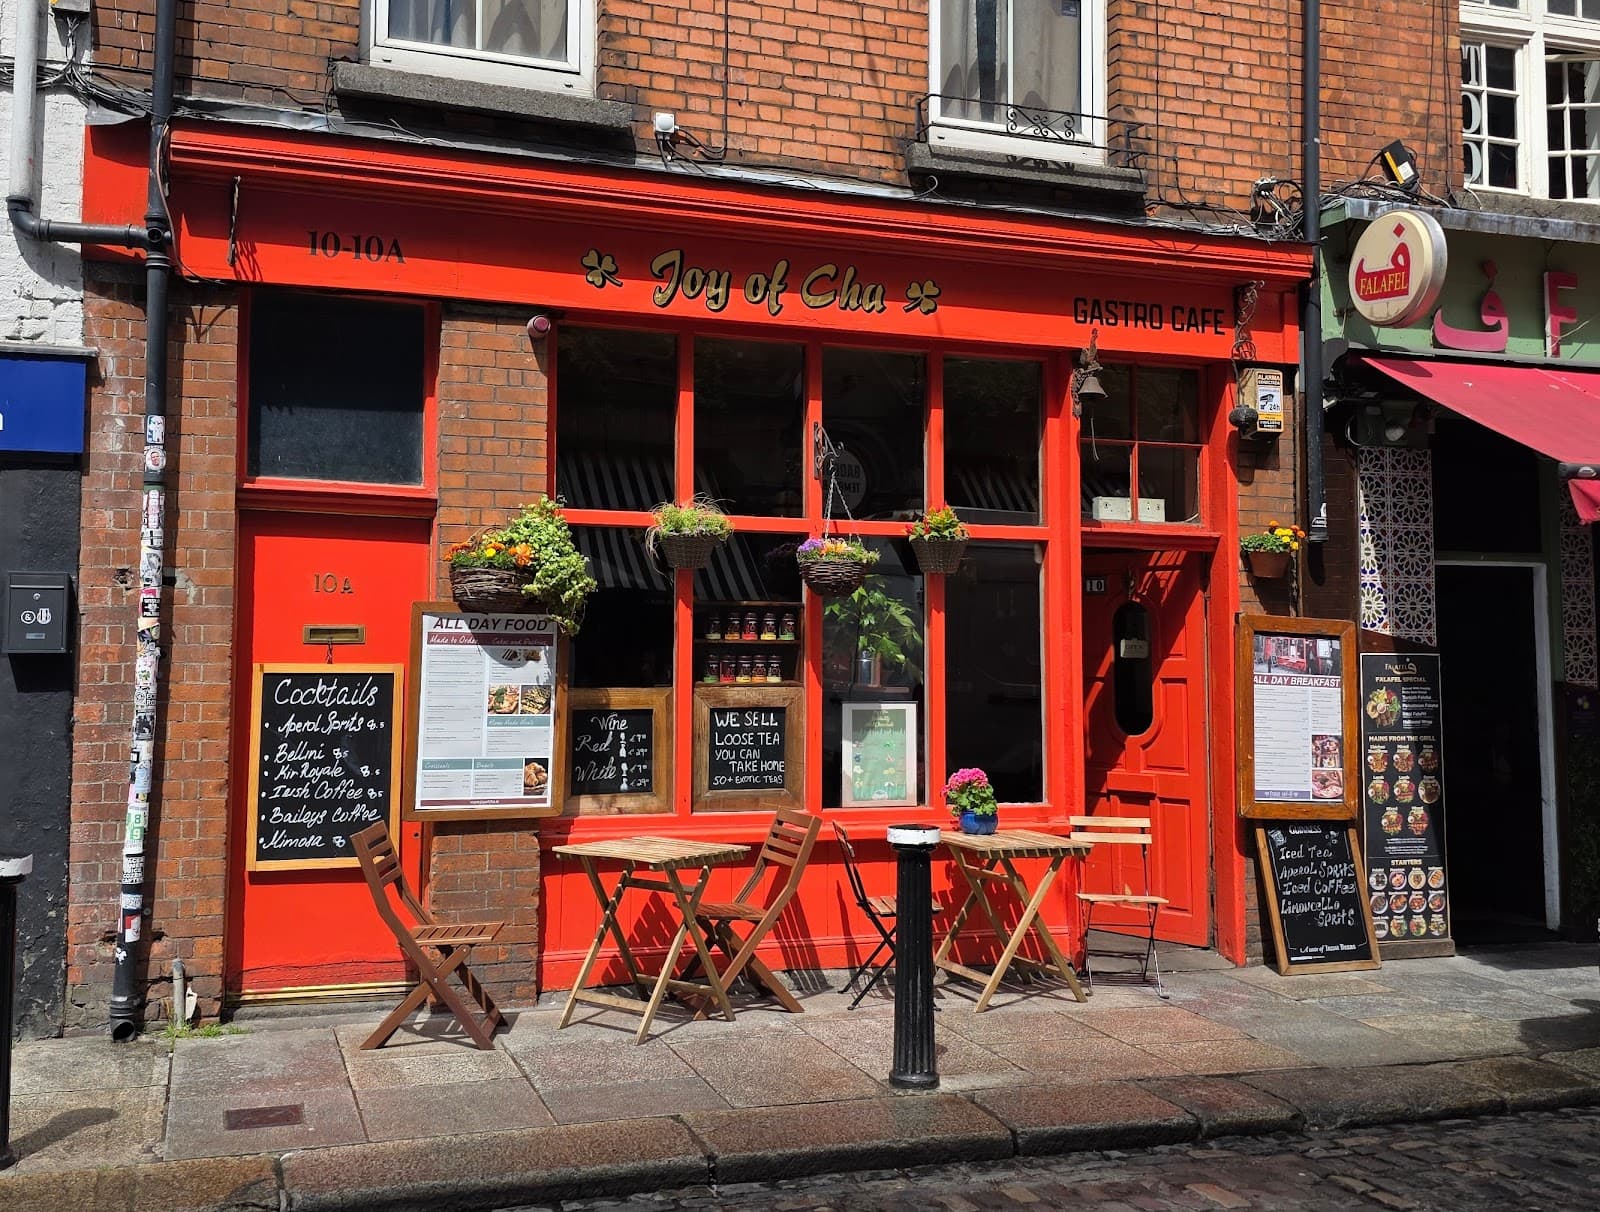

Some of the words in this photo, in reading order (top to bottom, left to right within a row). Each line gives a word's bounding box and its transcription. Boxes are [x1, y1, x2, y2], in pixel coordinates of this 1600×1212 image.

[307, 230, 406, 264] 10-10A
[651, 249, 732, 313] Joy
[744, 259, 790, 316] of
[801, 263, 887, 313] Cha
[1359, 273, 1408, 297] FALAFEL
[1073, 297, 1164, 331] GASTRO
[1171, 305, 1226, 336] CAFE
[313, 571, 354, 594] 10A
[1088, 579, 1104, 591] 10
[433, 617, 463, 630] ALL
[468, 618, 502, 631] DAY
[504, 618, 548, 632] FOOD
[275, 676, 379, 707] Cocktails
[1254, 675, 1269, 684] ALL
[1271, 676, 1290, 685] DAY
[1291, 677, 1341, 688] BREAKFAST
[277, 713, 323, 738] Aperol
[591, 712, 629, 731] Wine
[714, 711, 741, 728] WE
[744, 710, 778, 727] SELL
[575, 731, 614, 752] Red
[715, 731, 755, 746] LOOSE
[756, 732, 780, 746] TEA
[274, 740, 325, 764] Bellini
[714, 748, 736, 761] YOU
[739, 748, 761, 760] CAN
[274, 763, 300, 781] Kir
[300, 759, 346, 784] Royale
[575, 756, 617, 782] White
[728, 760, 758, 774] TAKE
[760, 760, 785, 773] HOME
[314, 778, 363, 799] Coffee
[712, 775, 734, 786] 50+
[735, 774, 761, 784] EXOTIC
[762, 774, 783, 784] TEAS
[269, 804, 328, 828] Baileys
[331, 803, 382, 823] Coffee
[262, 829, 326, 849] Mimosa
[1279, 844, 1305, 860] Iced
[1308, 845, 1333, 858] Tea
[1282, 877, 1312, 896] Iced
